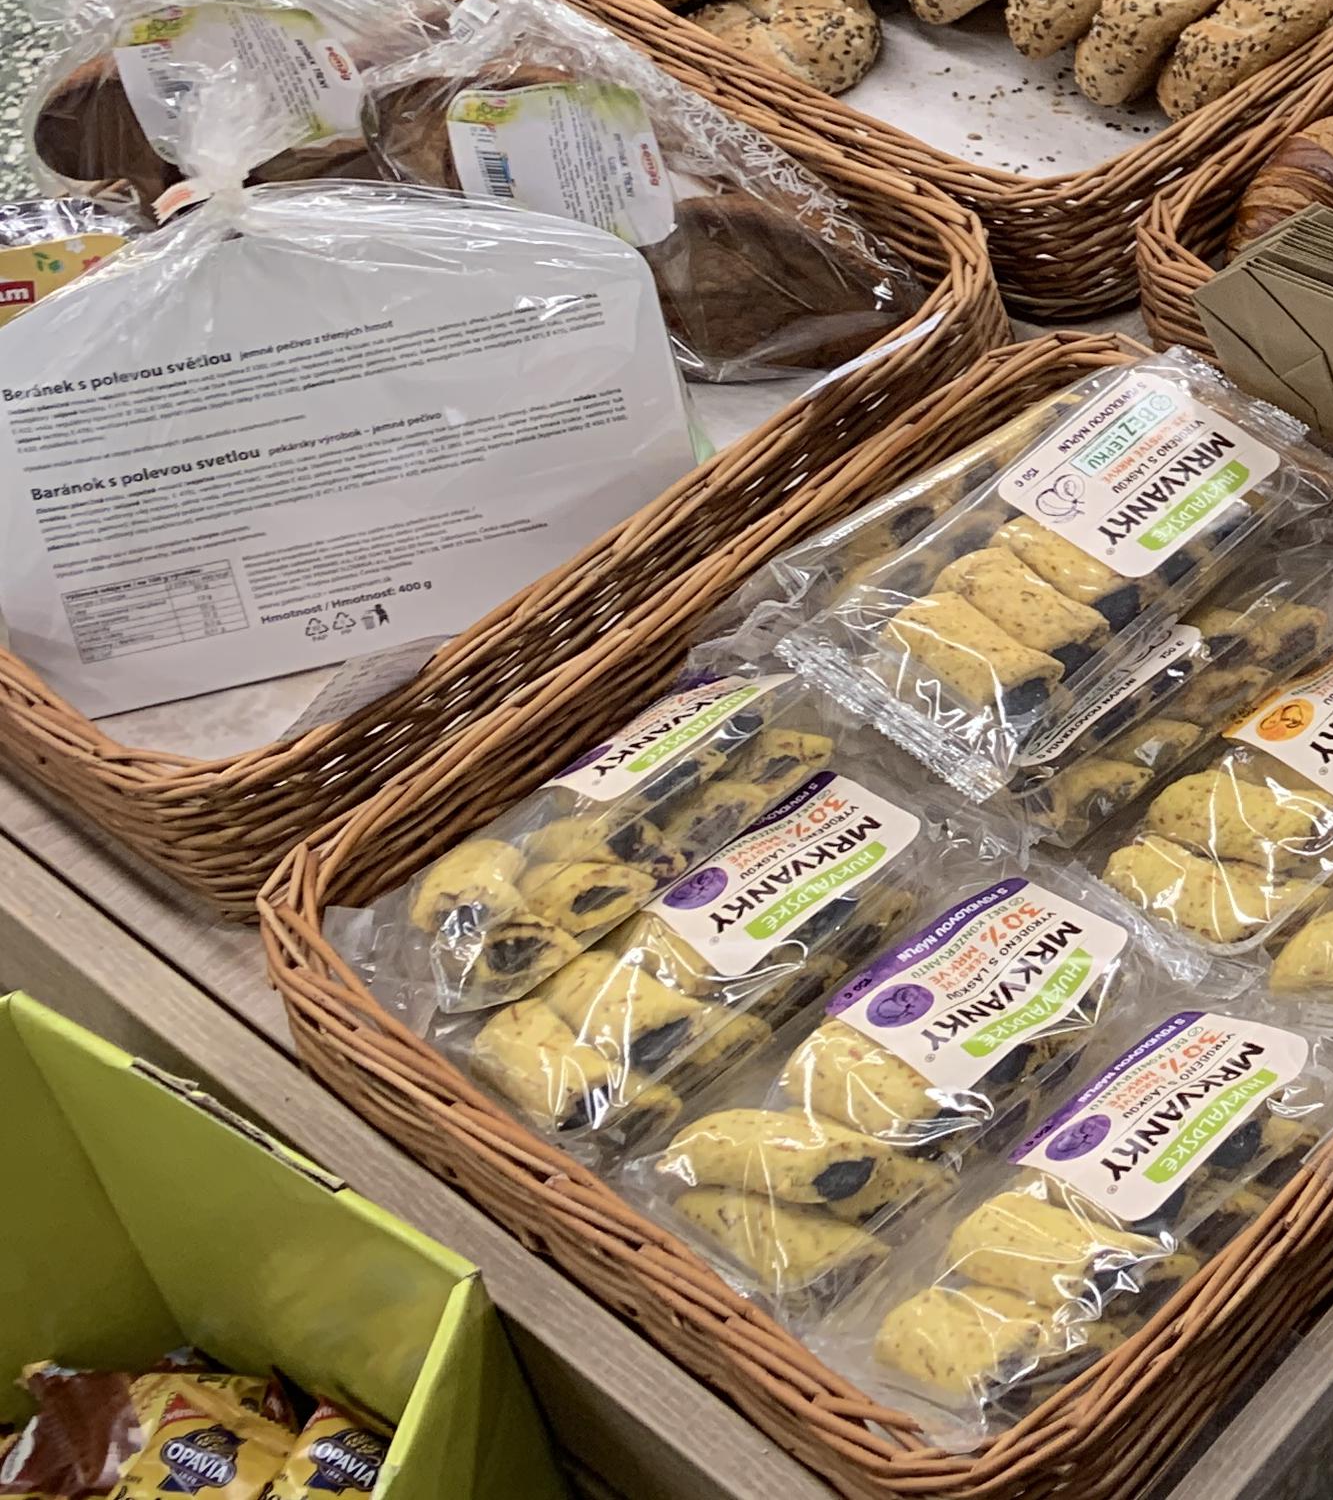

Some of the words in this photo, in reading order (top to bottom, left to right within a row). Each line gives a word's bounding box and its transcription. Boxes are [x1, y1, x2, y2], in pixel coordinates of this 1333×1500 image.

[2, 380, 74, 403] Beránek
[77, 378, 87, 391] s
[92, 364, 164, 391] polevou
[166, 350, 233, 375] světlou
[276, 337, 311, 354] pečivo
[313, 336, 321, 345] z
[364, 320, 394, 336] hmot
[30, 476, 106, 501] Baránok
[107, 474, 117, 488] s
[121, 460, 193, 487] polevou
[195, 447, 261, 470] svetlou
[1110, 462, 1150, 495] LÁSKOU
[1147, 454, 1158, 465] S
[1150, 468, 1238, 545] HUKVALDSKÉ
[260, 603, 323, 625] Hmotnost
[398, 582, 422, 595] 400
[423, 579, 433, 591] g
[784, 790, 848, 842] 30%
[738, 845, 786, 880] LÁSKOU
[759, 848, 874, 933] HUKVALDSKÉ
[984, 902, 1010, 922] BEZ
[997, 886, 1009, 898] S
[931, 894, 996, 944] POVIDLOVOU
[979, 902, 1042, 950] 30%
[998, 908, 1055, 956] VYROBENO
[928, 942, 980, 986] MRKVÉ
[945, 966, 990, 1004] LÁSKOU
[987, 956, 1000, 969] S
[976, 961, 1084, 1051] HUKVALDSKÉ
[1172, 1015, 1184, 1028] S
[1112, 1022, 1176, 1073] POVIDLOVOU
[1158, 1025, 1224, 1077] 30%
[1165, 1036, 1189, 1055] BEZ
[1177, 1032, 1235, 1081] VYROBENO
[1121, 1082, 1166, 1120] LÁSKOU
[1157, 1073, 1264, 1174] HUKVALDSKÉ
[166, 1442, 229, 1483] OPAVIA
[314, 1442, 376, 1488] OPAVIA
